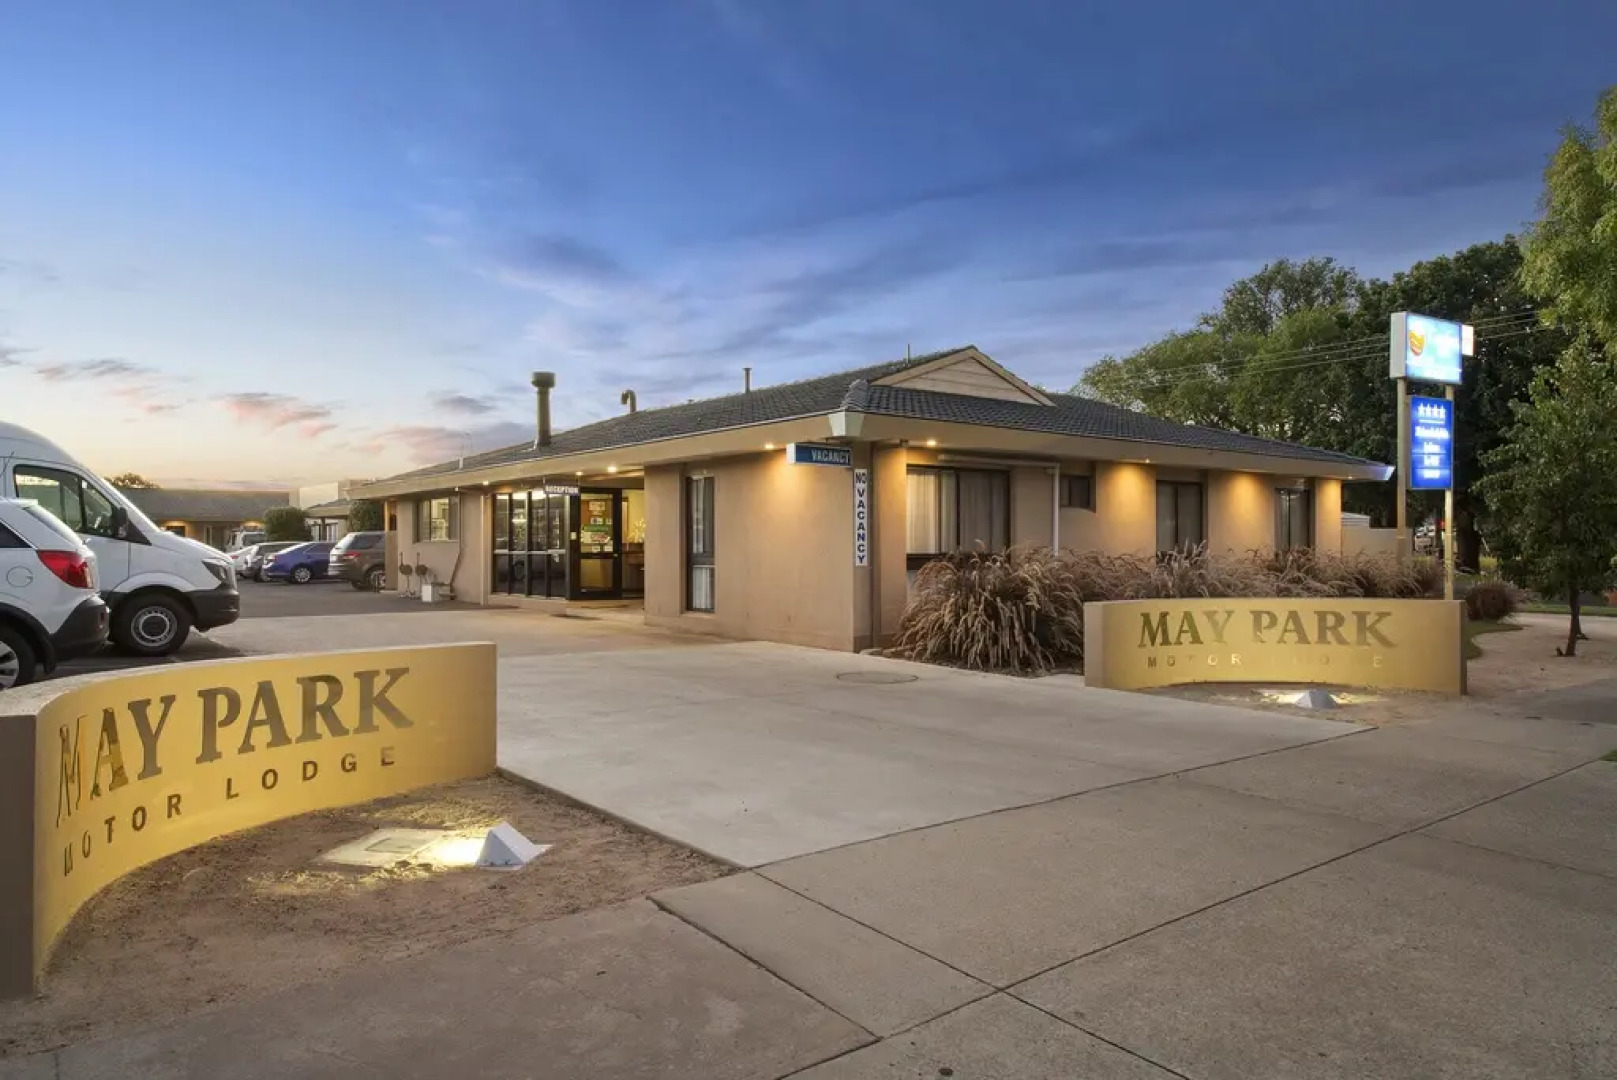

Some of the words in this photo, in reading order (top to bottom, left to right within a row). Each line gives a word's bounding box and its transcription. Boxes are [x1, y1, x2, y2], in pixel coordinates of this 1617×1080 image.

[811, 449, 850, 464] VACANCY
[545, 485, 579, 494] RECEPTION
[855, 471, 867, 484] NO
[856, 488, 866, 564] VACANCY
[1137, 610, 1235, 648] MAY
[1249, 610, 1398, 648] PARK
[1147, 653, 1242, 669] MOTOR
[56, 694, 176, 827] MAY
[195, 667, 414, 765] PARK
[64, 793, 182, 876] MOTOR
[225, 746, 396, 800] LODGE
